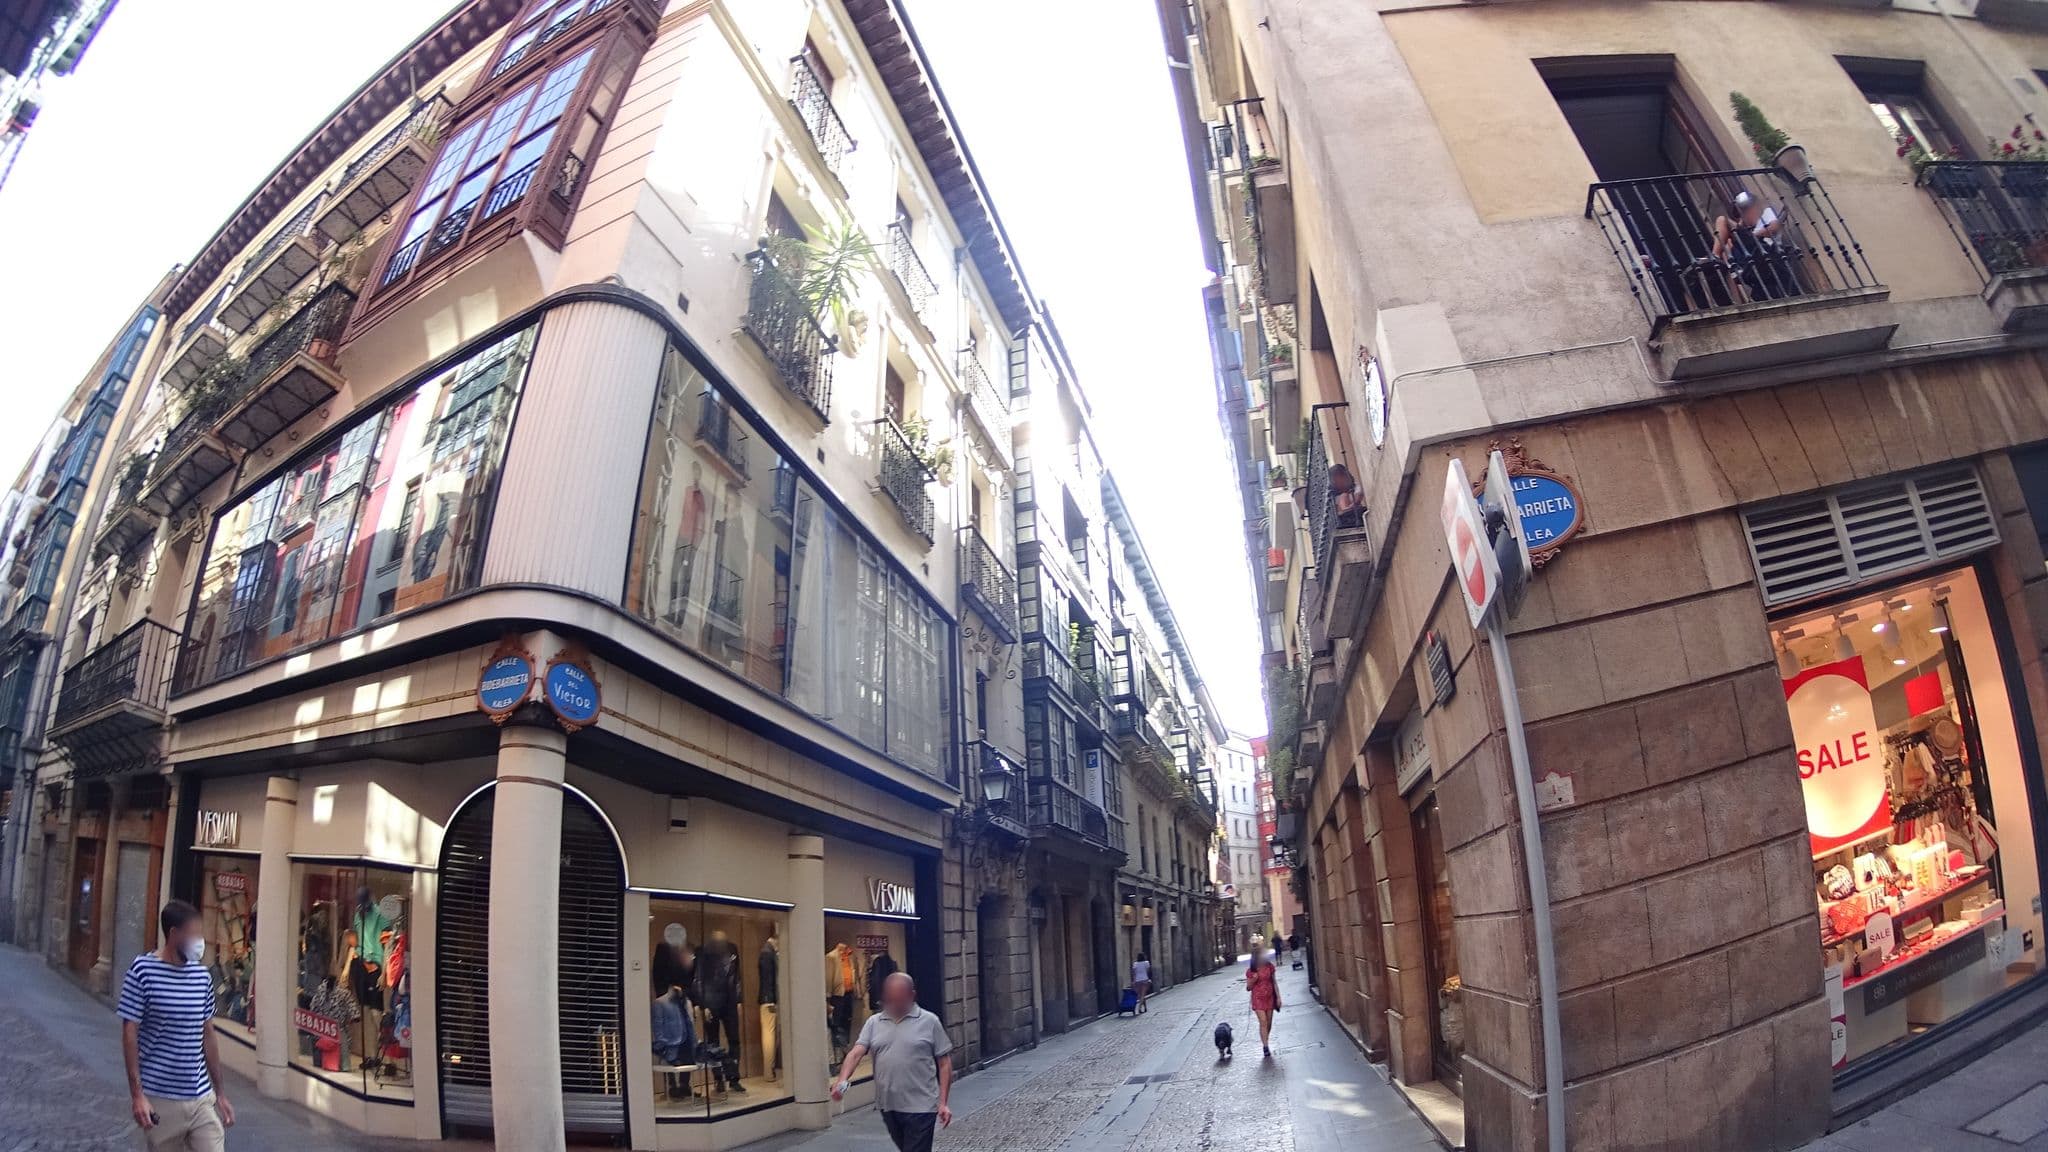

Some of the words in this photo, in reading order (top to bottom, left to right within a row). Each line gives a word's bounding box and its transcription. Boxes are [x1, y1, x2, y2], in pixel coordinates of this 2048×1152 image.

[1512, 478, 1539, 491] LLE
[1516, 496, 1573, 518] ARRIETA
[1525, 528, 1554, 542] LEA
[496, 657, 519, 669] CALLE
[564, 667, 585, 683] CALLE
[1797, 731, 1871, 780] SALE
[197, 810, 239, 845] VESMAN
[868, 877, 916, 914] VESMAN
[1869, 928, 1892, 944] SALE
[295, 1011, 337, 1037] REBAJAS
[1831, 1029, 1844, 1041] LE
